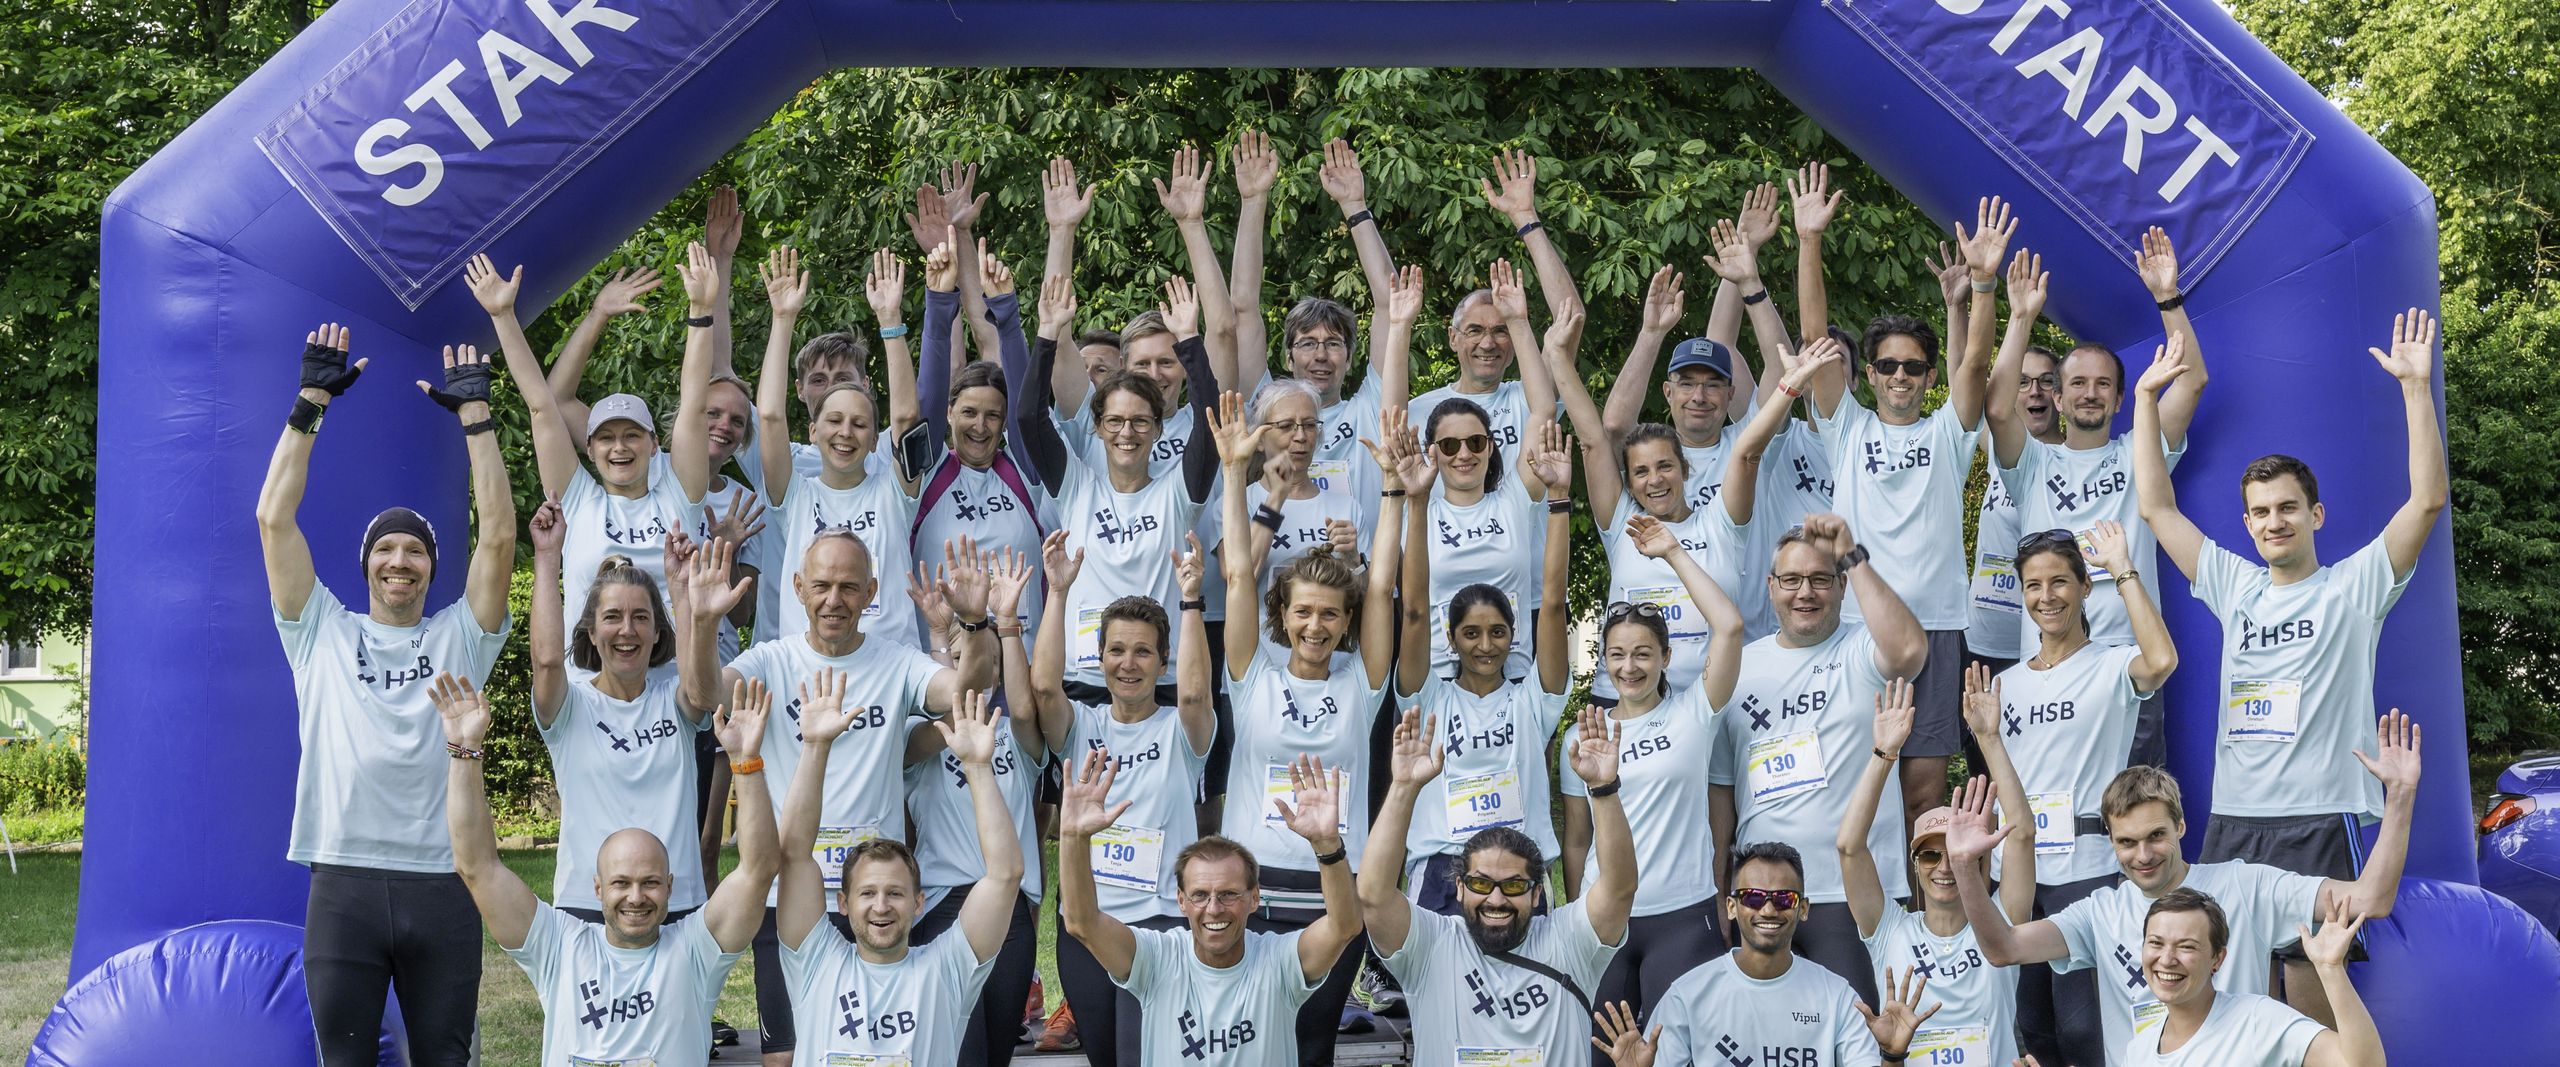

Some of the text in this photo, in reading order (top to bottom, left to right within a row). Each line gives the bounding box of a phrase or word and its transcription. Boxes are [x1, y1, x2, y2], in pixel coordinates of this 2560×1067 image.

[1936, 0, 2240, 203] TART
[1491, 425, 1518, 448] SB
[2084, 471, 2126, 502] HSB
[1121, 515, 1159, 544] HSB
[1299, 528, 1331, 542] HS
[1992, 572, 2016, 590] 130
[1662, 604, 1682, 621] 30
[2262, 619, 2314, 648] HSB
[385, 655, 434, 690] HSB
[852, 705, 885, 731] SB
[1782, 690, 1827, 720] HSB
[2030, 700, 2076, 724] HSB
[2244, 699, 2273, 716] 130
[634, 719, 678, 748] HSB
[1471, 723, 1514, 749] HSB
[1621, 735, 1672, 763] HSB
[1763, 753, 1796, 775] 130
[1469, 792, 1501, 812] 130
[1103, 842, 1135, 862] 130
[610, 990, 654, 1024] HSB
[1501, 983, 1549, 1020] HSB
[868, 1010, 916, 1041] HSB
[1791, 1011, 1821, 1025] Vipul
[1209, 1019, 1257, 1054] HSB
[1763, 1046, 1818, 1067] HSB
[1930, 1047, 1965, 1066] 130
